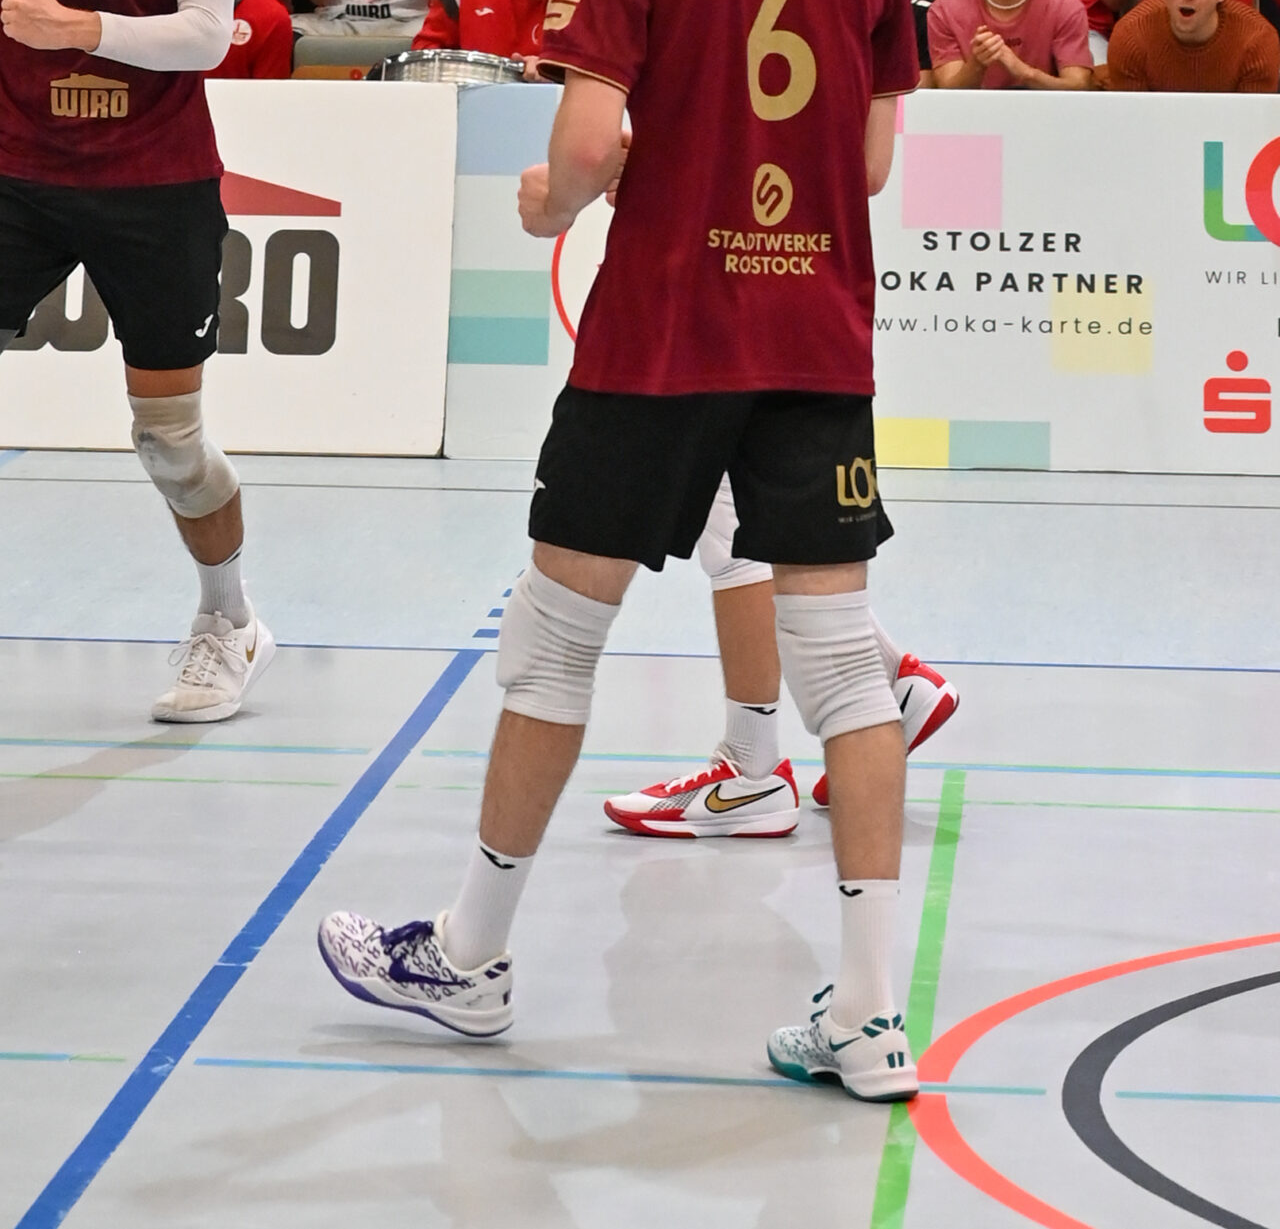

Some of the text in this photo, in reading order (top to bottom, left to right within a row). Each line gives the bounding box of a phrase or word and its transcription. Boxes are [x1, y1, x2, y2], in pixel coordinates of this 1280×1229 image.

[50, 88, 128, 118] WIRO
[708, 228, 831, 252] STADTWERKE
[922, 231, 1082, 253] STOLZER
[725, 254, 816, 276] ROSTOCK
[880, 271, 1143, 294] OKA PARTNER
[1205, 270, 1247, 284] WIR
